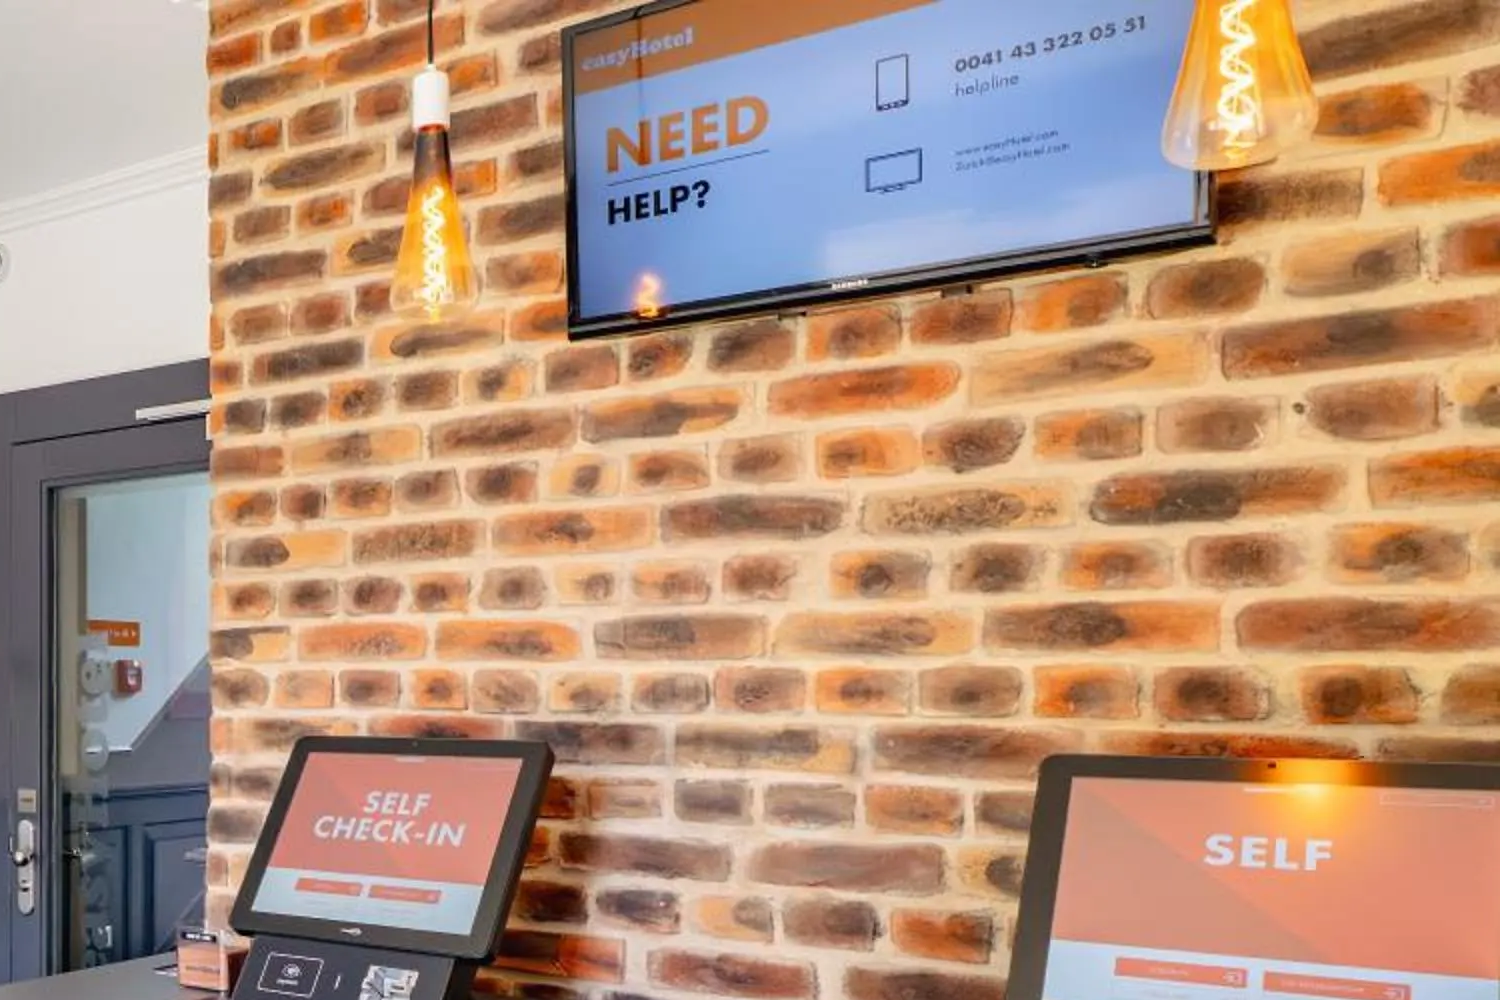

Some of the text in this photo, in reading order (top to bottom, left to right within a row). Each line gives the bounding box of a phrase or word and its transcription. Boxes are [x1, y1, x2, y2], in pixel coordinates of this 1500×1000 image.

[582, 27, 694, 71] easyHotel
[955, 49, 1003, 72] 0041
[1011, 41, 1037, 59] 43
[1043, 31, 1084, 53] 322
[1089, 22, 1117, 42] 05
[955, 74, 1020, 97] helpline
[606, 95, 770, 173] NEED
[607, 179, 711, 225] HELP?
[363, 791, 431, 815] SELF
[313, 815, 467, 847] CHECK-IN
[1203, 833, 1334, 871] SELF
